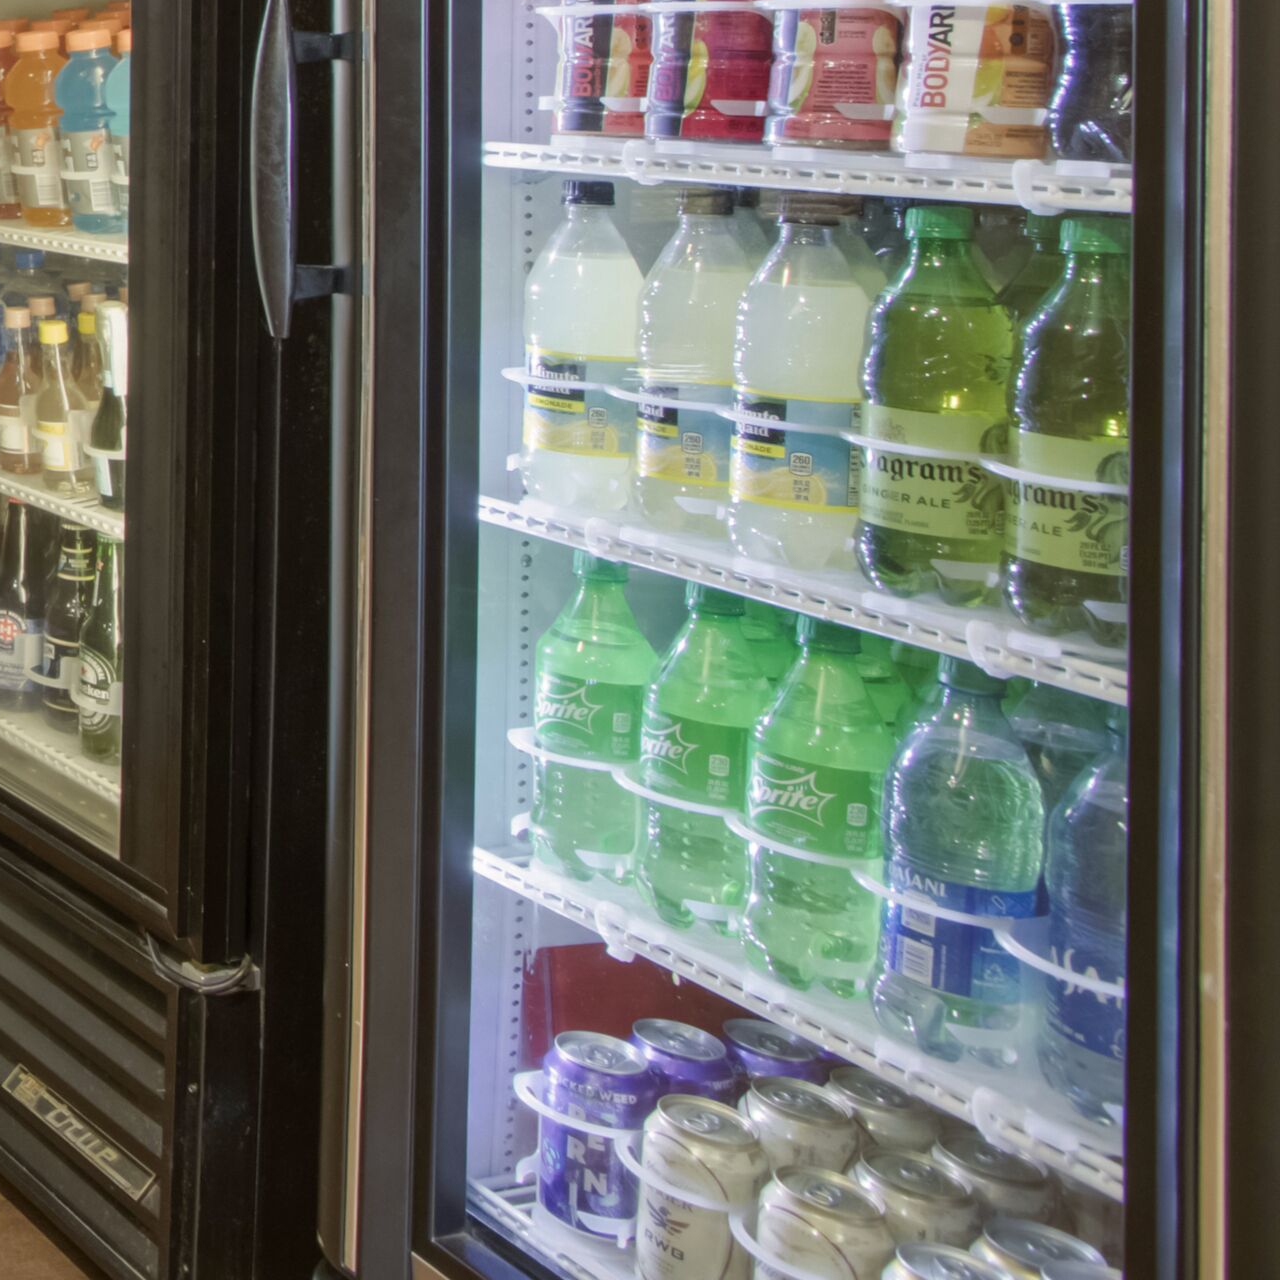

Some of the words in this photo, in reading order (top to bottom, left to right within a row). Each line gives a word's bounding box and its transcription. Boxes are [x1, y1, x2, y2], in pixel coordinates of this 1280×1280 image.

[530, 366, 580, 382] inute
[532, 397, 573, 410] MONADE
[736, 421, 770, 438] aid
[792, 454, 811, 465] 260
[858, 453, 984, 484] agram's
[862, 483, 911, 505] GINGER
[916, 495, 952, 510] ALE
[1006, 479, 1100, 514] gram's
[1030, 520, 1063, 538] ALE
[642, 733, 684, 760] prite
[893, 866, 946, 898] ASANI
[598, 1089, 638, 1106] WEED
[644, 1228, 686, 1261] RWB
